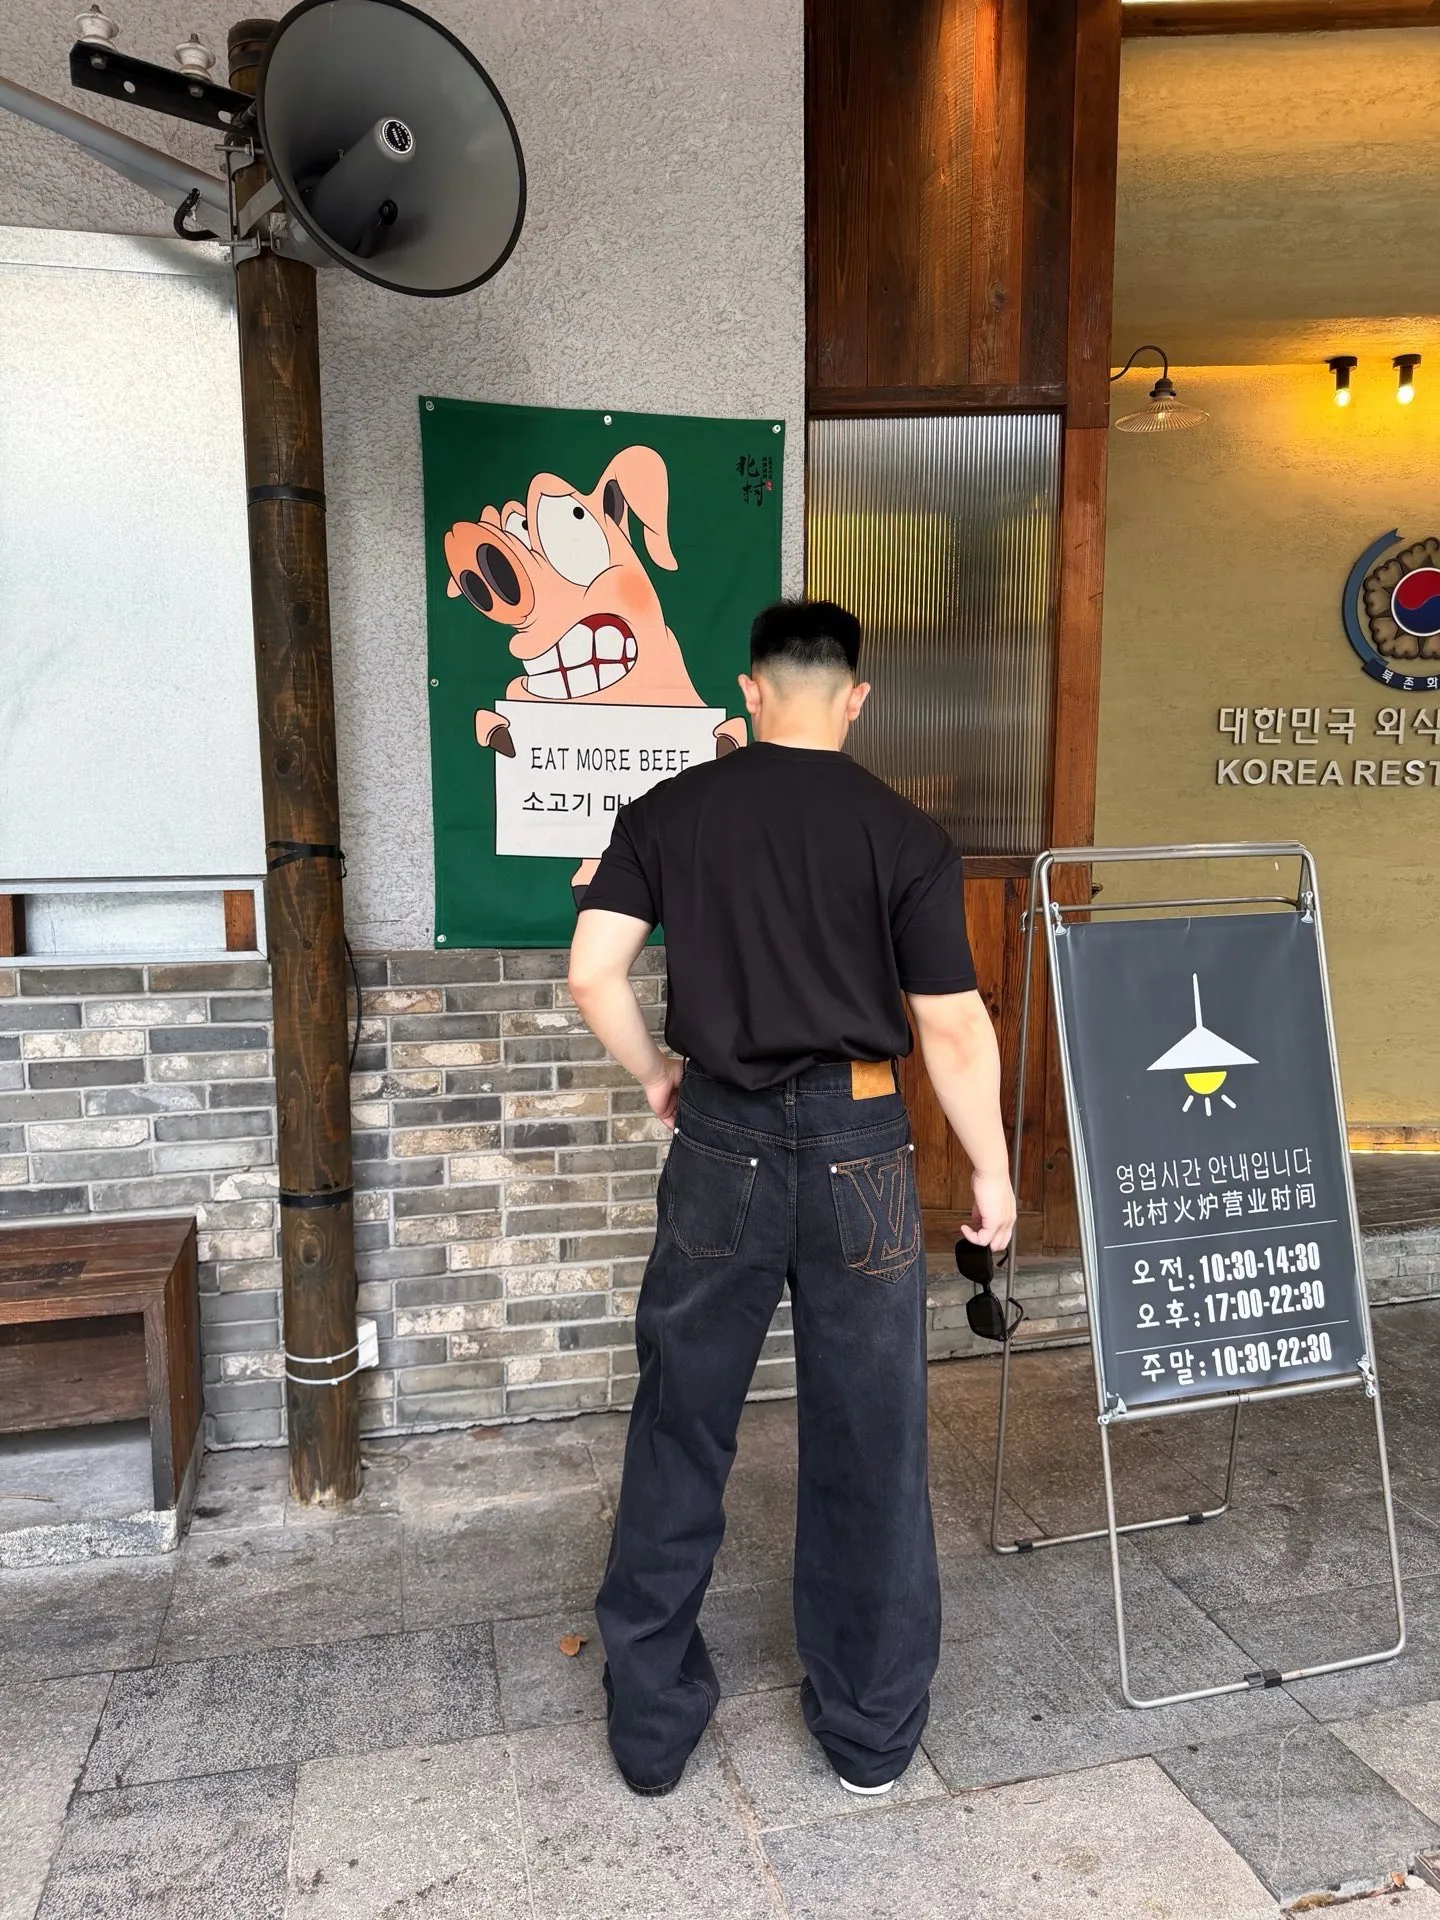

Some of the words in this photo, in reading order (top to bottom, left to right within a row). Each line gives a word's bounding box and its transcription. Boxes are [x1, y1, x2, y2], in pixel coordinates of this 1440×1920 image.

[1219, 707, 1357, 744] 대한민국
[530, 747, 569, 771] EAT
[577, 748, 630, 772] MORE
[639, 749, 690, 772] BEEF
[1217, 758, 1345, 786] KOREA
[522, 791, 591, 817] 소고기
[1116, 1157, 1201, 1194] 영업시간
[1208, 1147, 1312, 1184] 안내입니다
[1122, 1183, 1316, 1228] 北村火炉营业时间
[1199, 1242, 1320, 1284] 10:30-14:30
[1204, 1280, 1325, 1323] 17:00-22:30
[1211, 1332, 1332, 1377] 10:30-22:30
